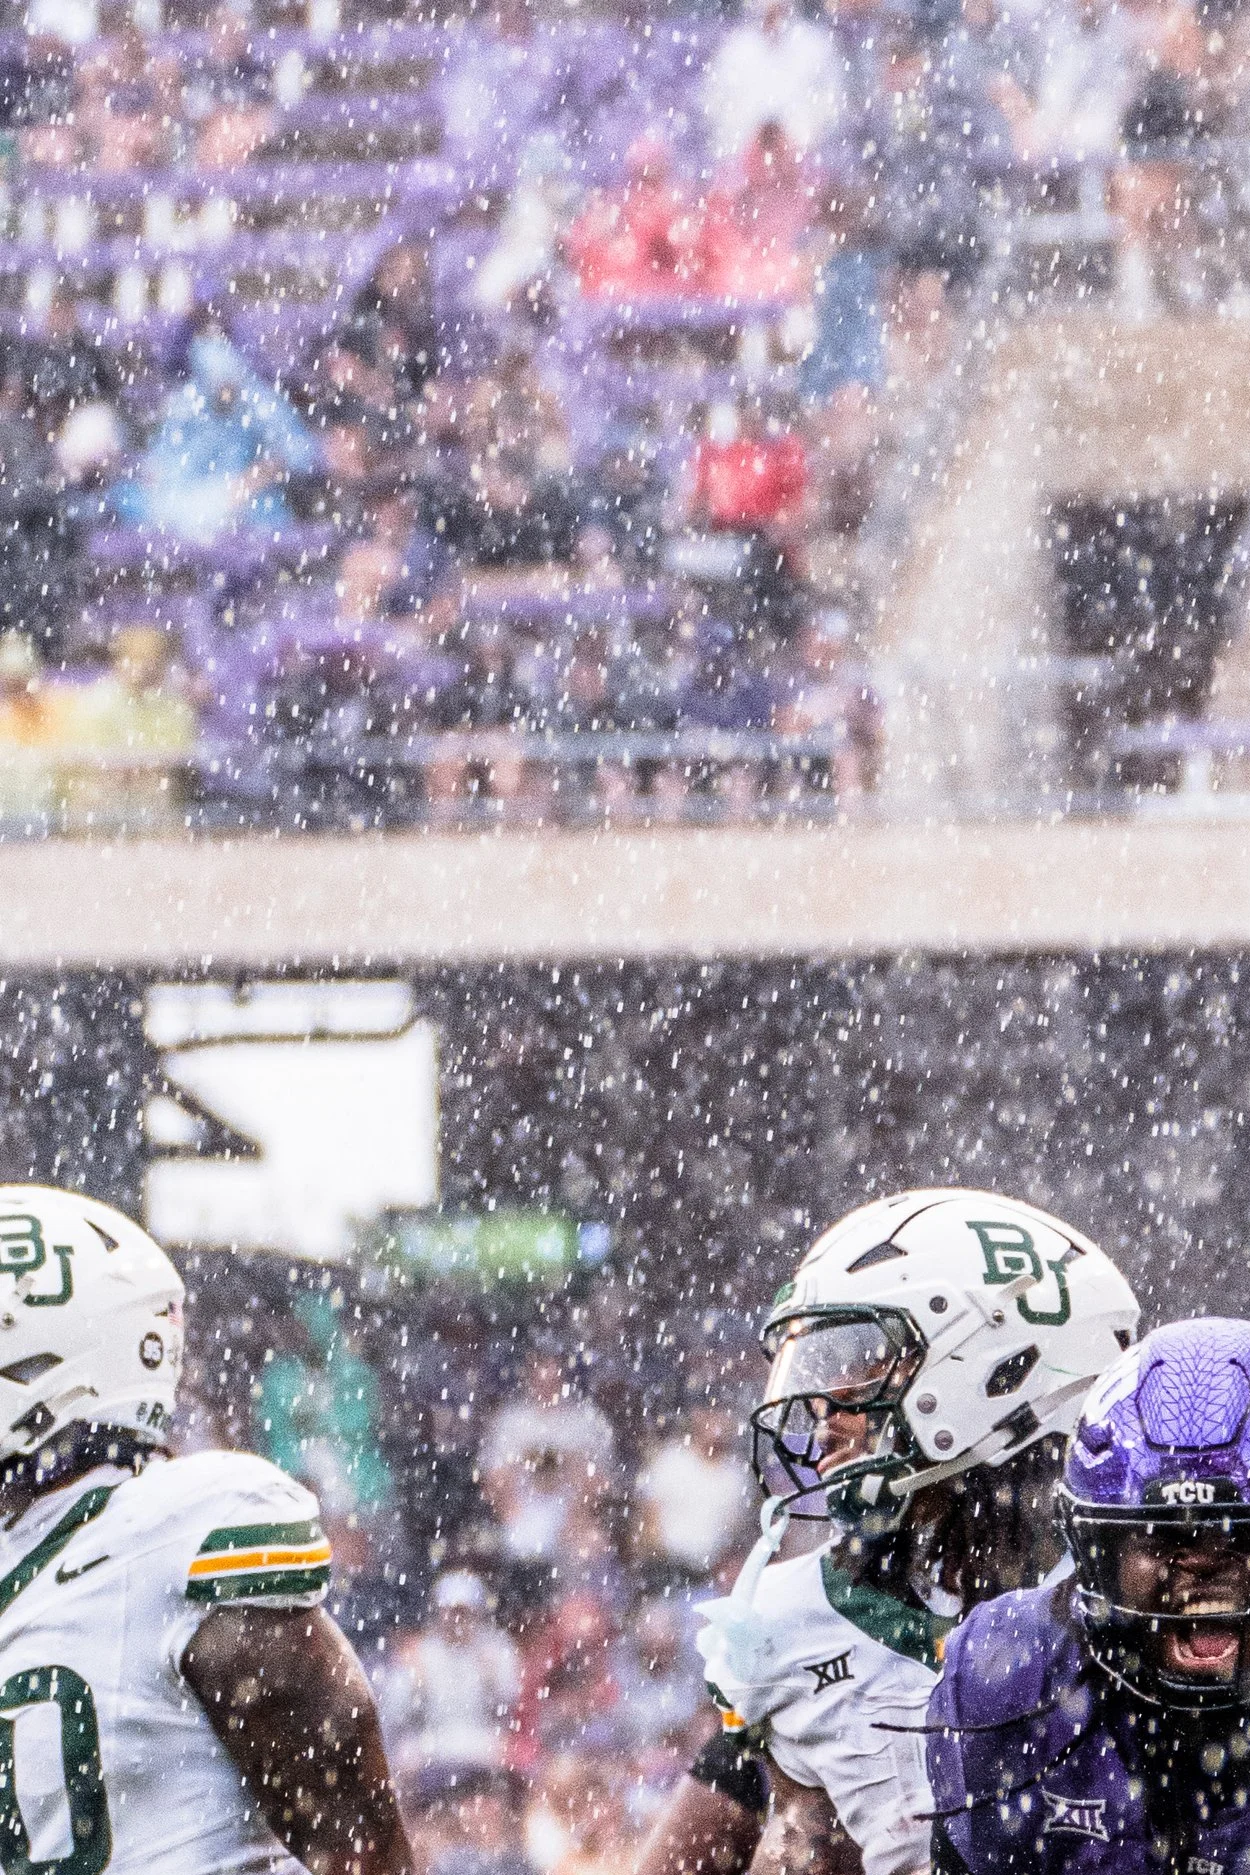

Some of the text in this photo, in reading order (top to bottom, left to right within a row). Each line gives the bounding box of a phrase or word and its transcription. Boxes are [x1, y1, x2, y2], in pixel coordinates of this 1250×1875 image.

[965, 1220, 1073, 1326] BU
[1161, 1480, 1216, 1505] TCU
[803, 1646, 855, 1694] XII
